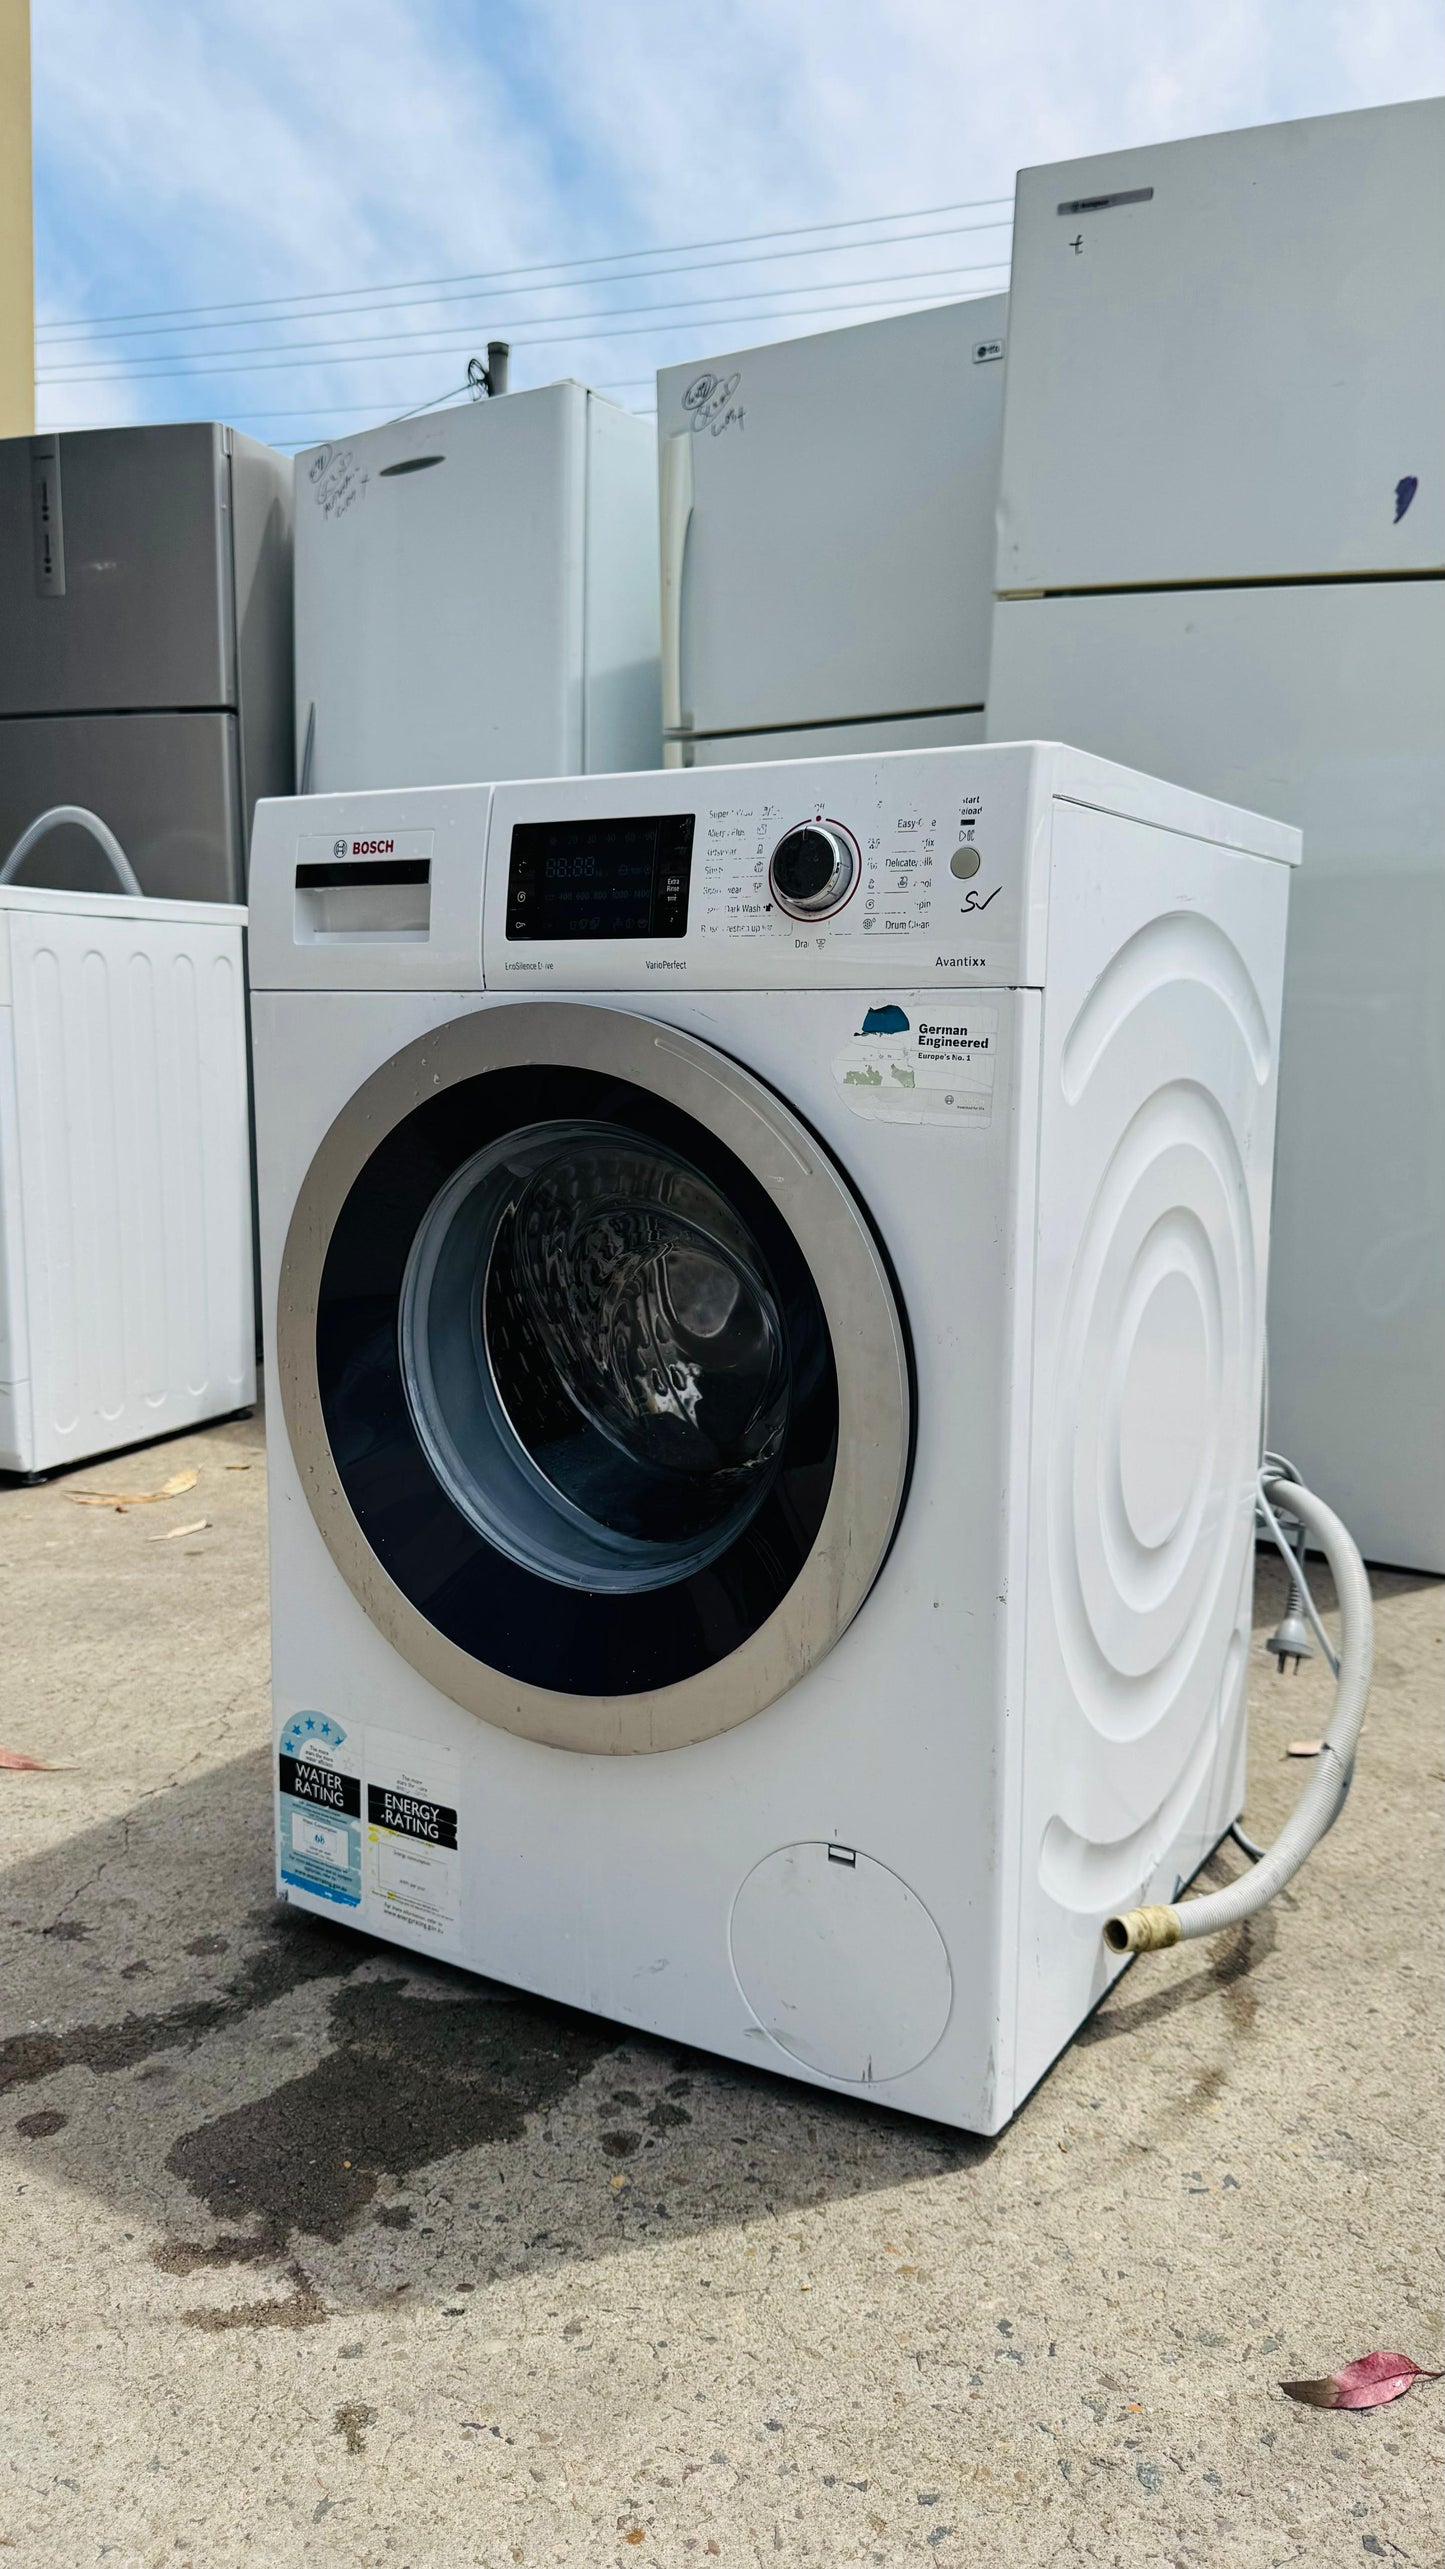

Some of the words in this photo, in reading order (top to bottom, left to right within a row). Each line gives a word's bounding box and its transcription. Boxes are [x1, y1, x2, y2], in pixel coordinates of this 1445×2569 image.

[959, 806, 983, 815] eload
[352, 839, 394, 855] BOSCH
[742, 904, 761, 912] Wash
[885, 920, 907, 929] Drum
[935, 956, 986, 967] Avantixx
[918, 1023, 968, 1036] German
[918, 1035, 989, 1049] Engineered
[917, 1052, 951, 1061] Europe's
[951, 1053, 965, 1061] No.
[295, 1762, 344, 1791] WATER
[294, 1777, 345, 1807] RATING
[384, 1792, 440, 1823] ENERGY
[385, 1809, 440, 1839] RATING
